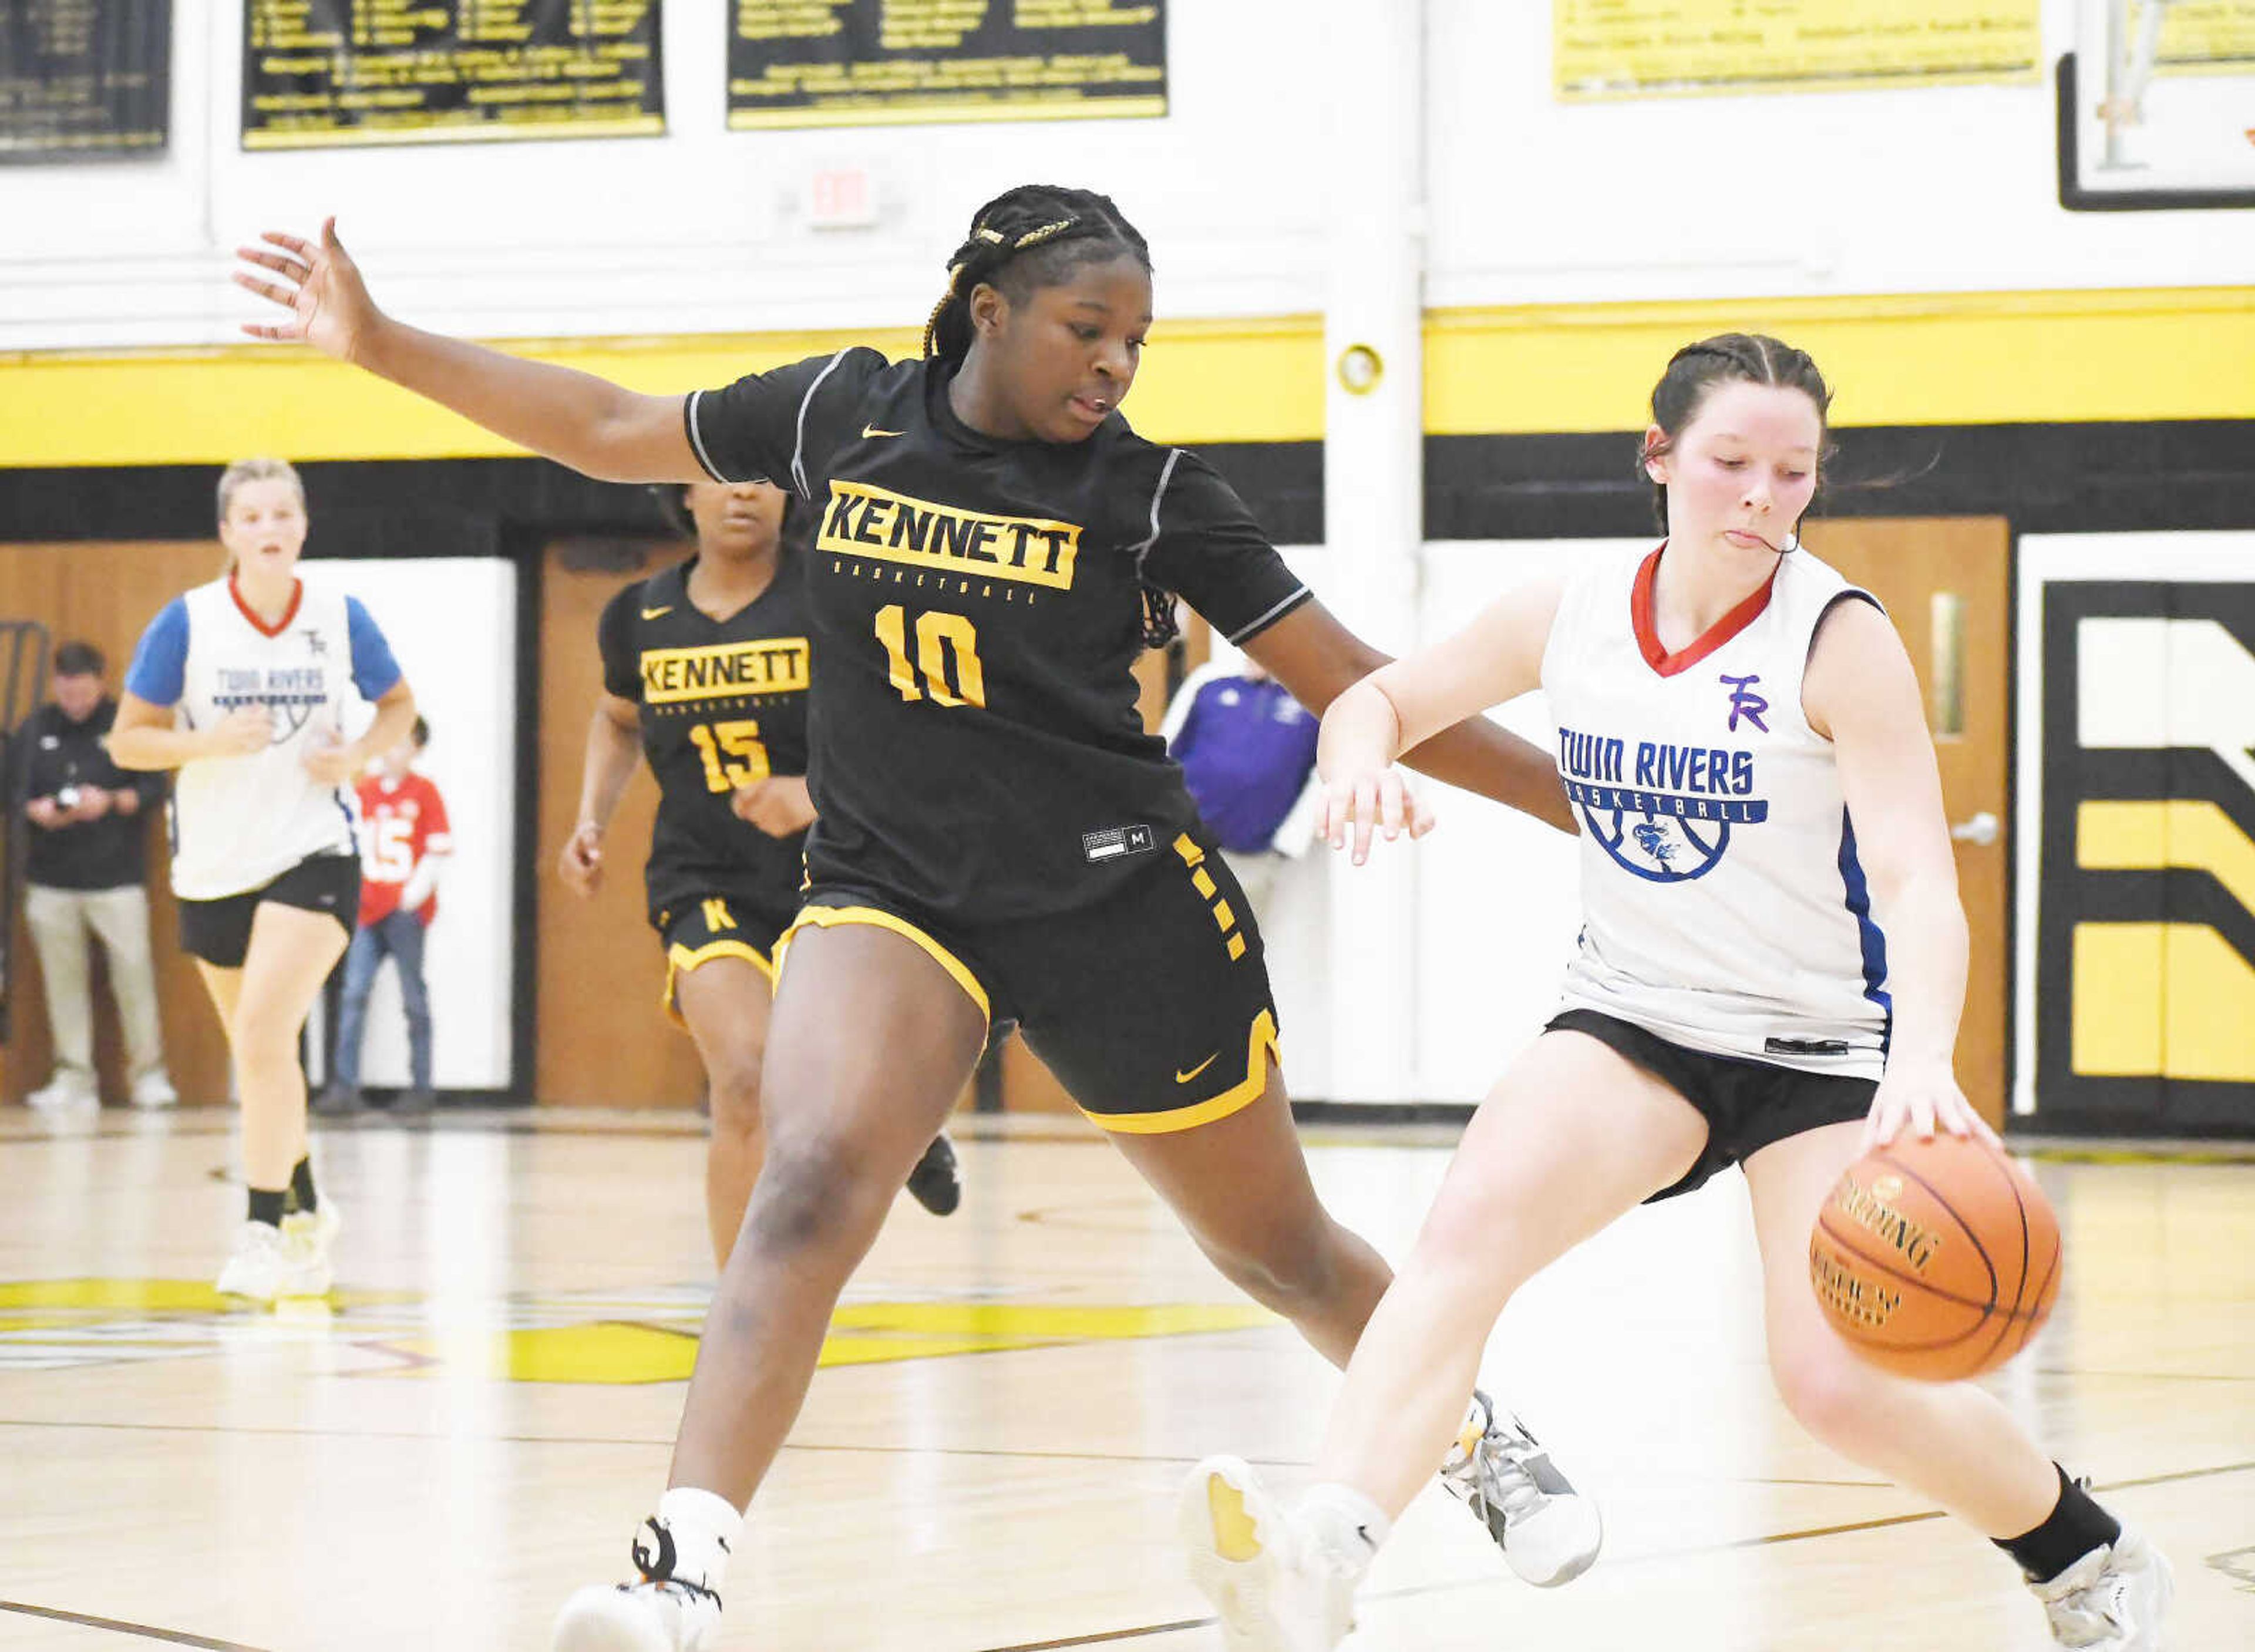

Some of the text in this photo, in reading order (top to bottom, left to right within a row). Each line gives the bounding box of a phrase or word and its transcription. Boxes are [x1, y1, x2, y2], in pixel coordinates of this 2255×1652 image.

[826, 492, 1071, 575] KENNETT
[833, 560, 1036, 605] BASKETBALL
[647, 648, 801, 691] KENNETT
[874, 604, 987, 709] 10
[1719, 674, 1769, 734] TR
[689, 719, 771, 793] 15
[1559, 726, 1753, 796] TWIN RIVERS
[1132, 832, 1144, 844] M
[700, 896, 738, 933] K
